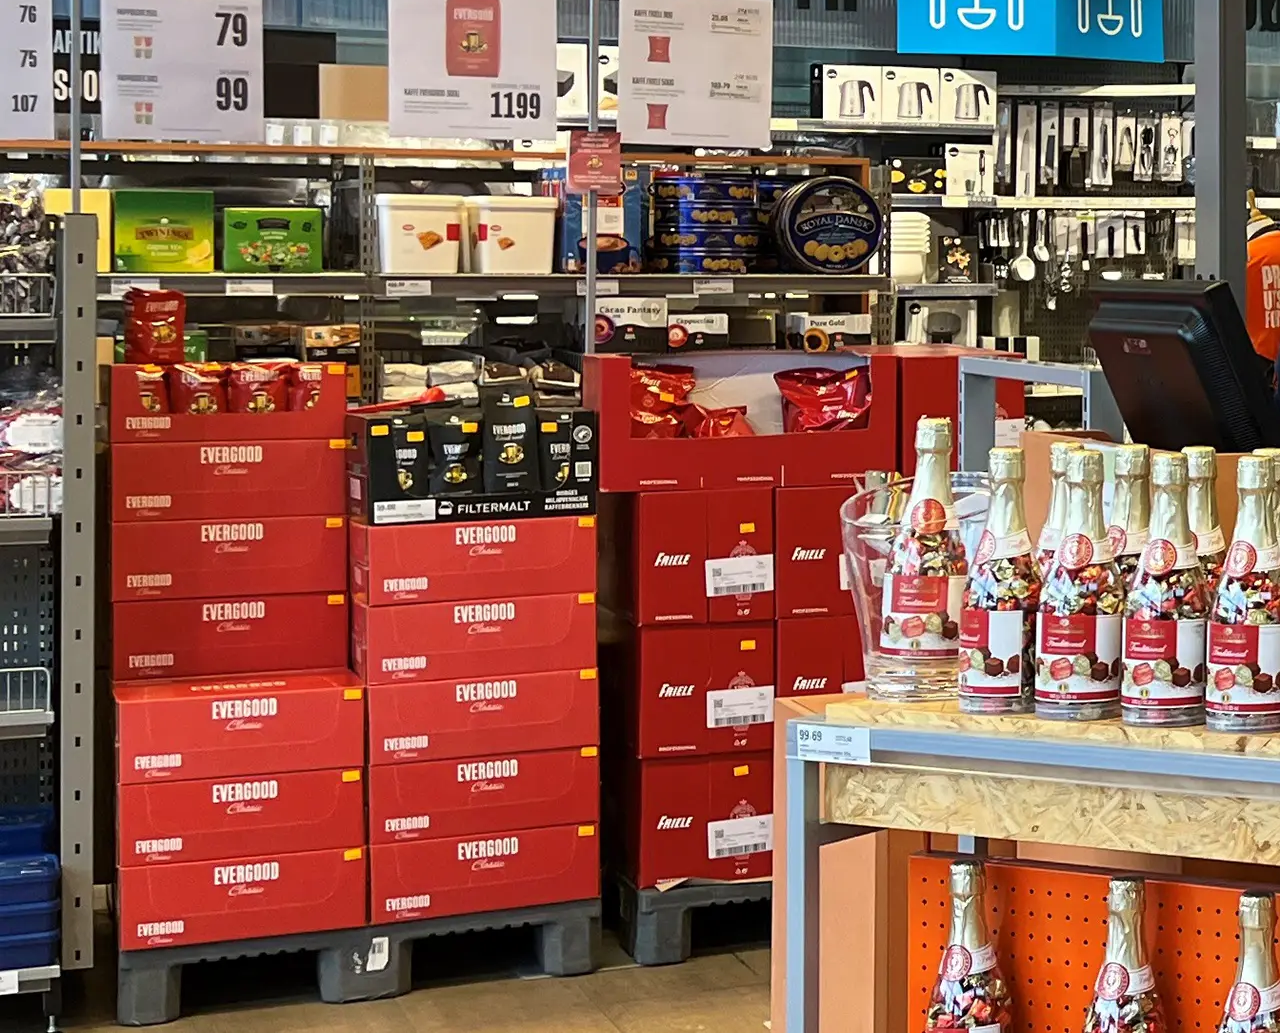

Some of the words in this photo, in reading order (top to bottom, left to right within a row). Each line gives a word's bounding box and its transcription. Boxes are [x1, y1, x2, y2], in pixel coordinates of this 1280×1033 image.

[19, 5, 37, 23] 76
[215, 13, 248, 47] 79
[20, 50, 38, 68] 75
[216, 77, 249, 111] 99
[12, 95, 38, 112] 107
[490, 91, 541, 119] 1199
[801, 216, 833, 232] ROYAL
[834, 215, 871, 229] DANSK
[599, 306, 625, 314] Cacao
[627, 306, 662, 315] Fantasy
[126, 417, 171, 429] EVERGOOD
[200, 446, 263, 464] EVERGOOD
[126, 495, 171, 508] EVERGOOD
[458, 500, 531, 514] FILTERMALT
[201, 524, 264, 543] EVERGOOD
[455, 525, 516, 546] EVERGOOD
[654, 553, 691, 567] FRIELE
[791, 547, 826, 561] FRIELE
[127, 574, 172, 588] EVERGOOD
[384, 577, 428, 593] EVERGOOD
[203, 602, 266, 622] EVERGOOD
[454, 603, 515, 625] EVERGOOD
[129, 653, 174, 668] EVERGOOD
[382, 657, 426, 672] EVERGOOD
[456, 681, 517, 702] EVERGOOD
[658, 683, 695, 698] FRIELE
[793, 676, 827, 690] FRIELE
[212, 698, 277, 720] EVERGOOD
[384, 735, 428, 752] EVERGOOD
[134, 754, 182, 770] EVERGOOD
[457, 759, 518, 782] EVERGOOD
[212, 781, 278, 804] EVERGOOD
[385, 815, 429, 832] EVERGOOD
[657, 816, 693, 830] FRIELE
[135, 838, 182, 854] EVERGOOD
[457, 837, 519, 861] EVERGOOD
[214, 862, 279, 886] EVERGOOD
[386, 895, 430, 911] EVERGOOD
[137, 921, 184, 937] EVERGOOD
